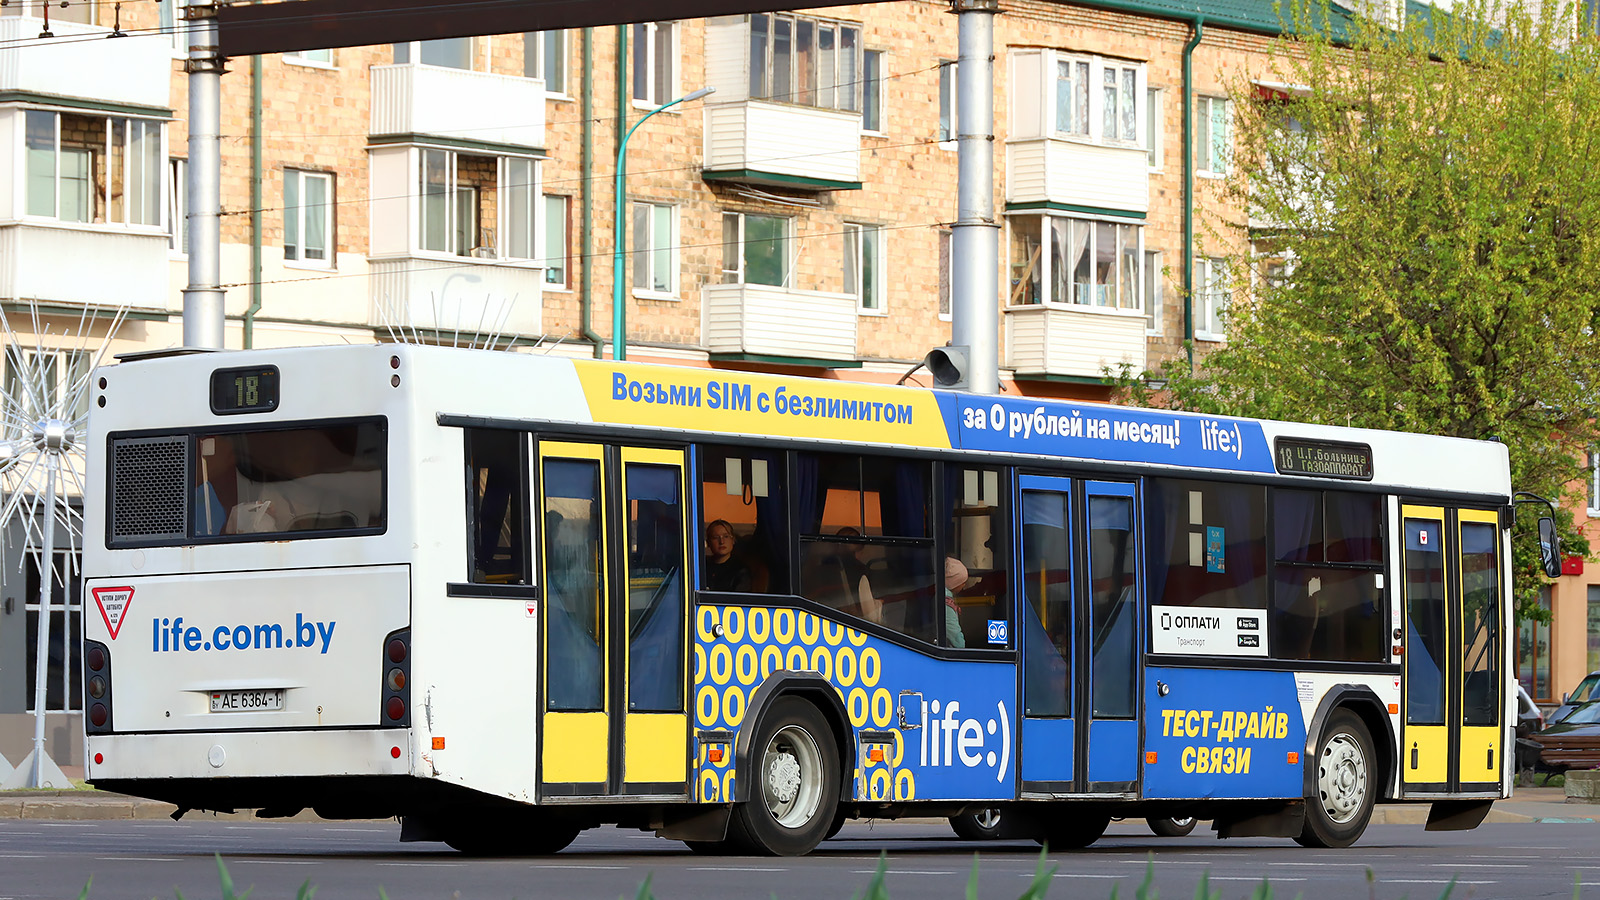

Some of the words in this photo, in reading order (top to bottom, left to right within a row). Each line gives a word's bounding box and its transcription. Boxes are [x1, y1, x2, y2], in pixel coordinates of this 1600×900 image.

[235, 376, 259, 406] 18
[612, 372, 701, 408] Возьми
[707, 381, 751, 412] SIM
[757, 392, 770, 413] с
[775, 386, 912, 424] безлимитом
[963, 407, 987, 430] за
[990, 403, 1006, 431] 0
[1009, 406, 1083, 439] рублей
[1086, 418, 1111, 440] на
[1113, 419, 1181, 449] месяц!
[1200, 419, 1243, 460] life:)
[1280, 447, 1294, 469] 18
[1302, 460, 1363, 476] ГАЗОАППАРАТ
[152, 613, 337, 654] life.com.by
[1174, 616, 1220, 630] ОПЛАТИ
[1177, 637, 1205, 648] Транспорт
[222, 693, 239, 708] AE
[241, 692, 279, 708] 6364-1
[1161, 706, 1289, 742] ТЕСТ-ДРАЙВ
[920, 699, 1011, 783] life:)
[1181, 746, 1252, 774] СВЯЗИ
